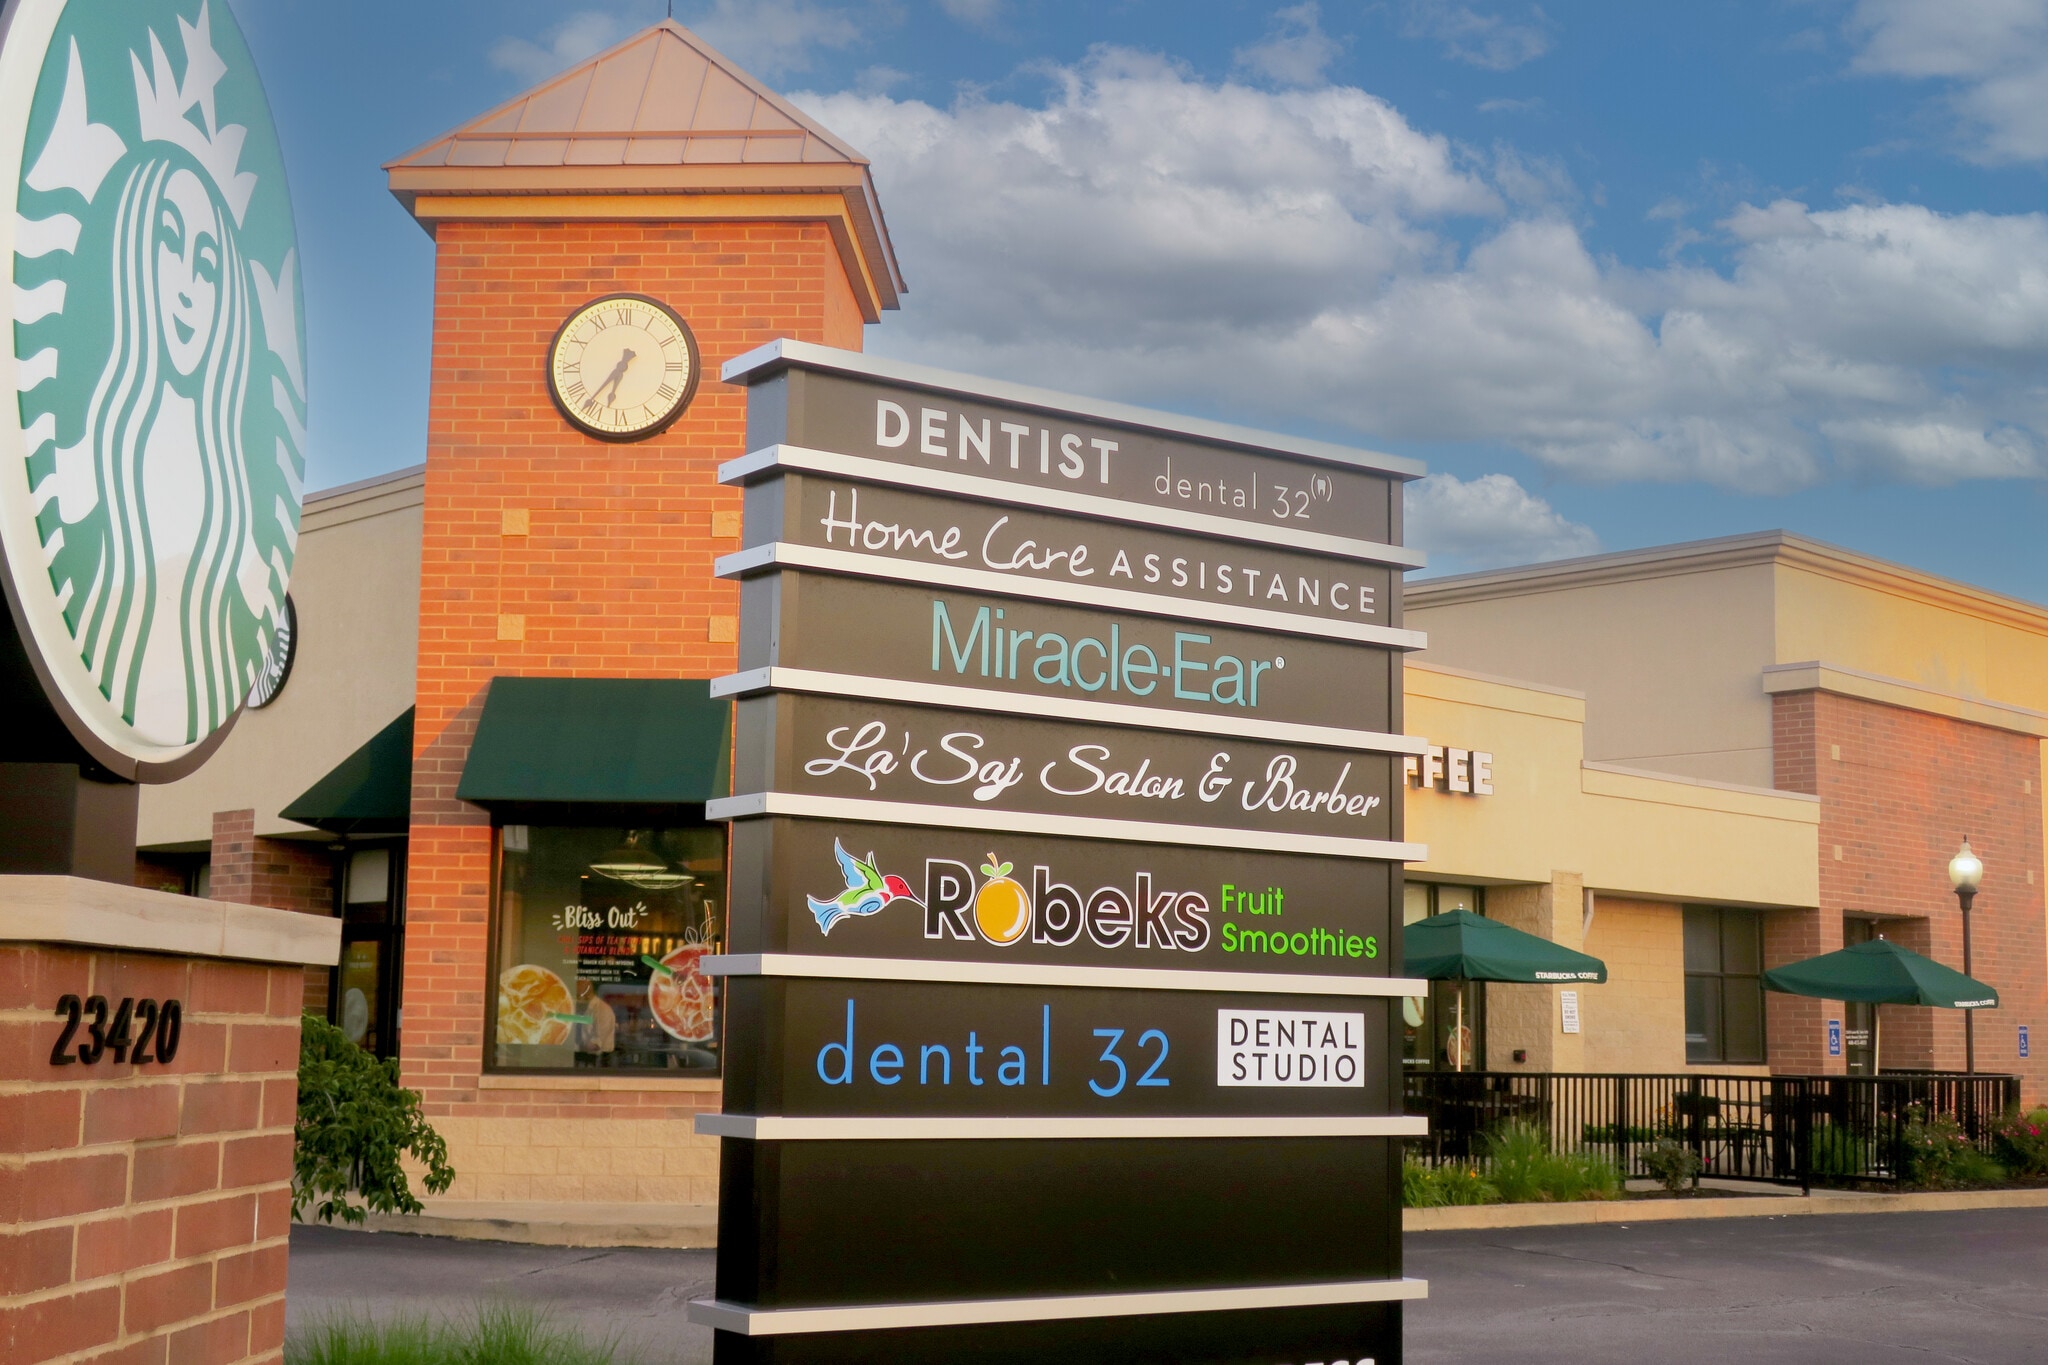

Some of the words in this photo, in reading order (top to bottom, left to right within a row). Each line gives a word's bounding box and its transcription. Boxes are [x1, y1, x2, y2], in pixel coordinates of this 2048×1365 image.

[875, 400, 1119, 485] DENTIST
[1155, 456, 1257, 510] dental
[1272, 485, 1310, 519] 32
[820, 488, 968, 560] Home
[982, 515, 1095, 577] Care
[1109, 549, 1376, 614] ASSISTANCE
[1039, 744, 1185, 800] Salon
[1198, 751, 1233, 803] &
[1241, 746, 1380, 817] Barber
[565, 905, 605, 930] Bliss
[607, 906, 639, 929] Out
[924, 852, 1211, 952] Robeks
[1222, 884, 1285, 916] Fruit
[1222, 922, 1378, 959] Smoothies
[49, 994, 182, 1067] 23420
[816, 998, 1051, 1087] dental
[1087, 1028, 1171, 1099] 32
[1230, 1018, 1358, 1049] DENTAL
[1231, 1053, 1357, 1082] STUDIO
